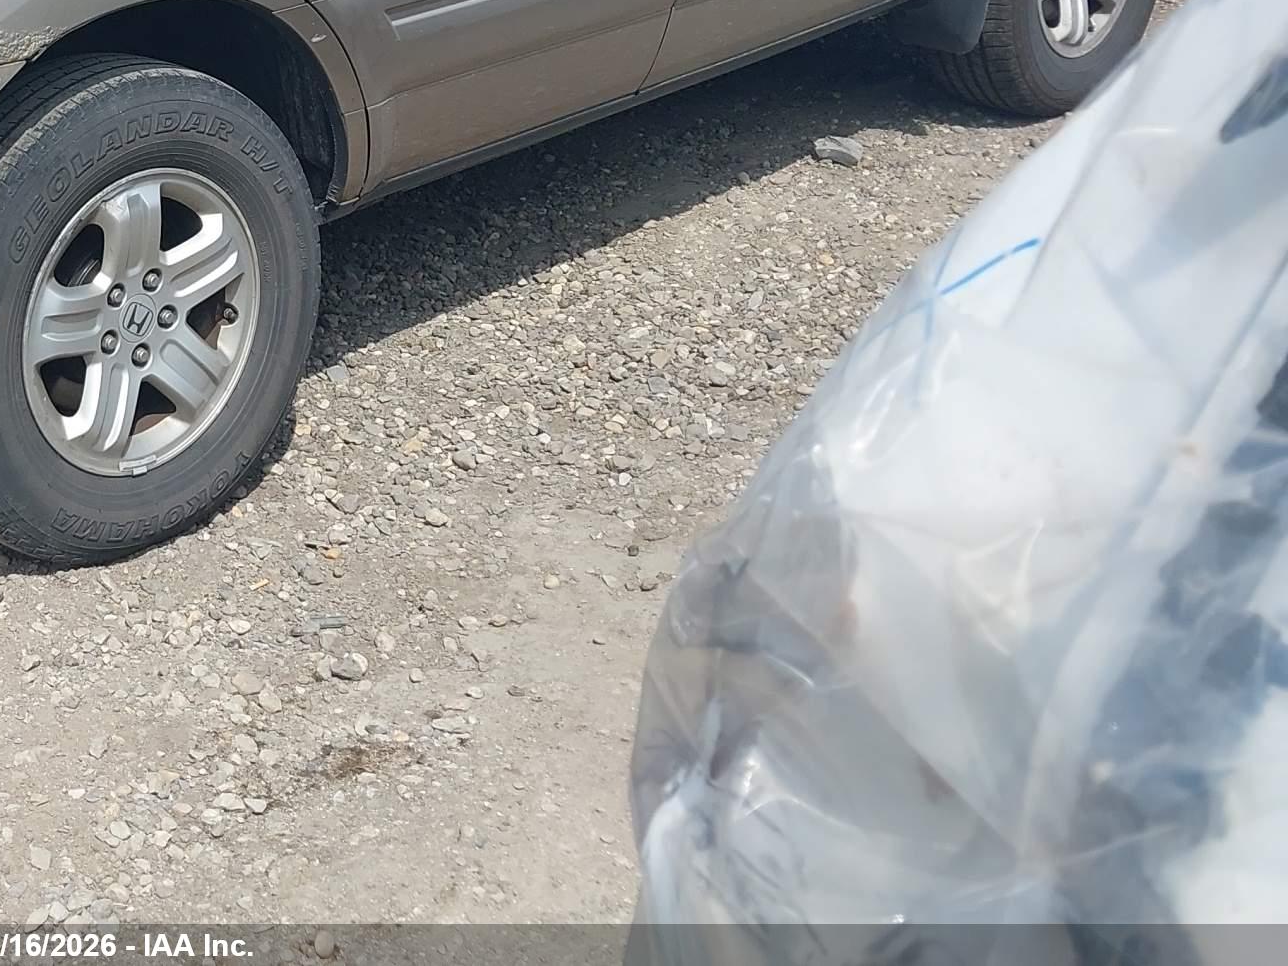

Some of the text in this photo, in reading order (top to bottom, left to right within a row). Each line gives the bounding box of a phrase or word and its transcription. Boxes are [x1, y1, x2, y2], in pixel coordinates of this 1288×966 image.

[9, 110, 236, 265] GEOLANDAR
[238, 134, 294, 196] H/T
[50, 450, 252, 544] YOKOHAMA
